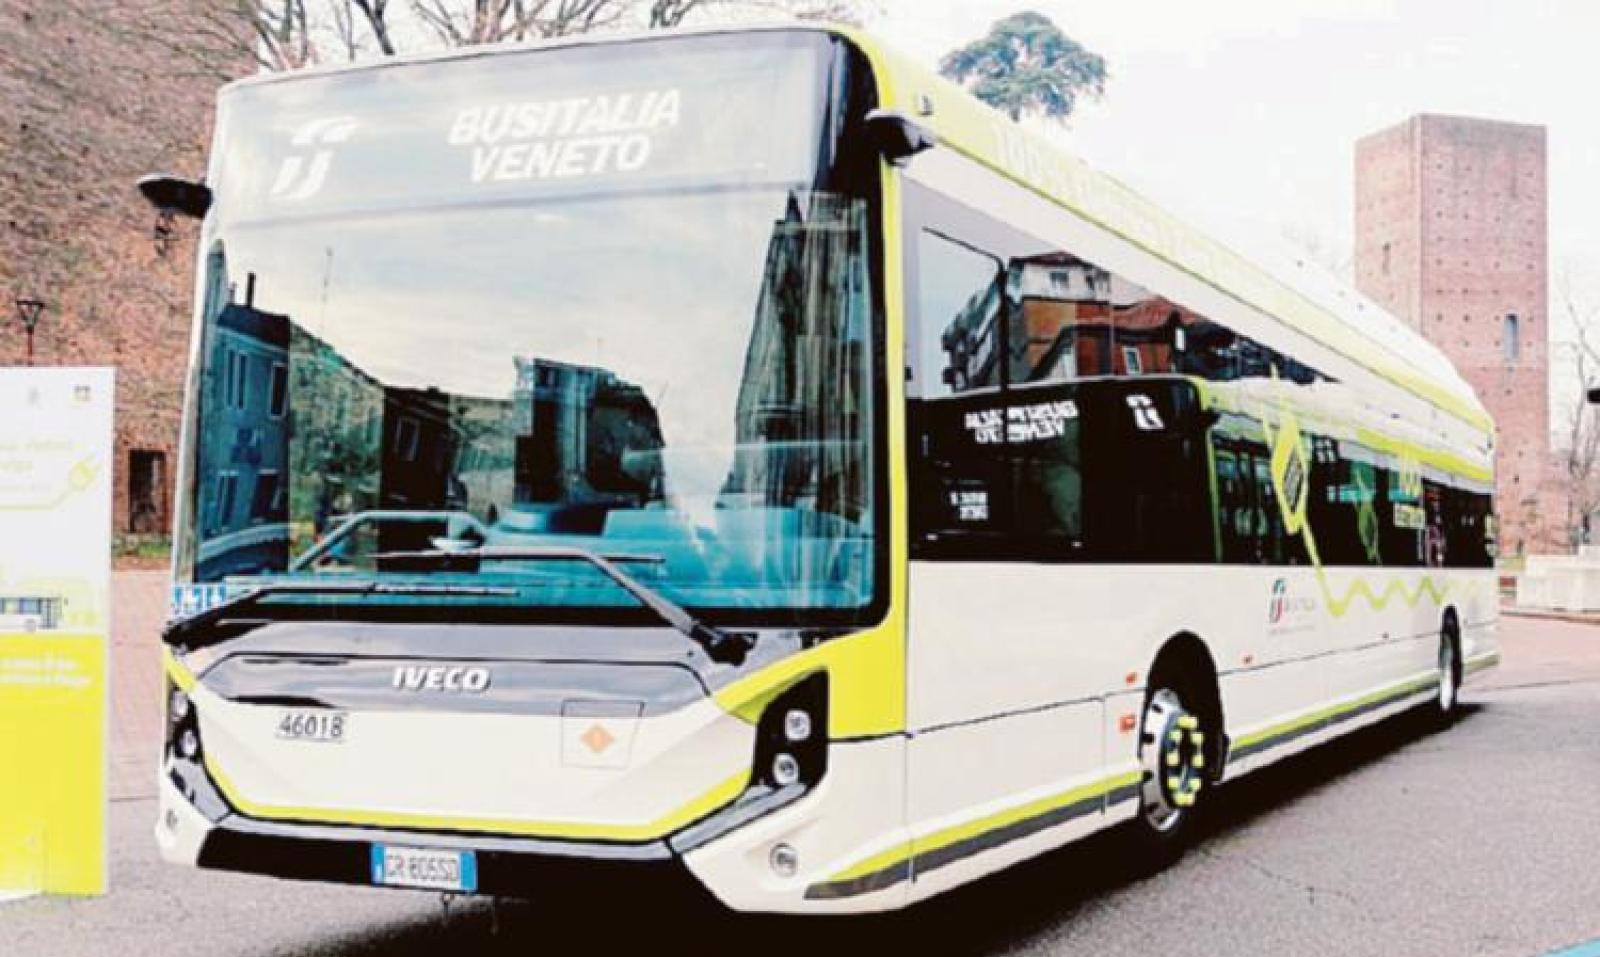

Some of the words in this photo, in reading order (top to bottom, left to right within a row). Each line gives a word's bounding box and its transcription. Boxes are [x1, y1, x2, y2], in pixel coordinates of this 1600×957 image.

[449, 90, 681, 144] BUSITALIA
[472, 134, 650, 182] VENETO
[393, 667, 491, 692] IVECO
[279, 714, 343, 738] 46018
